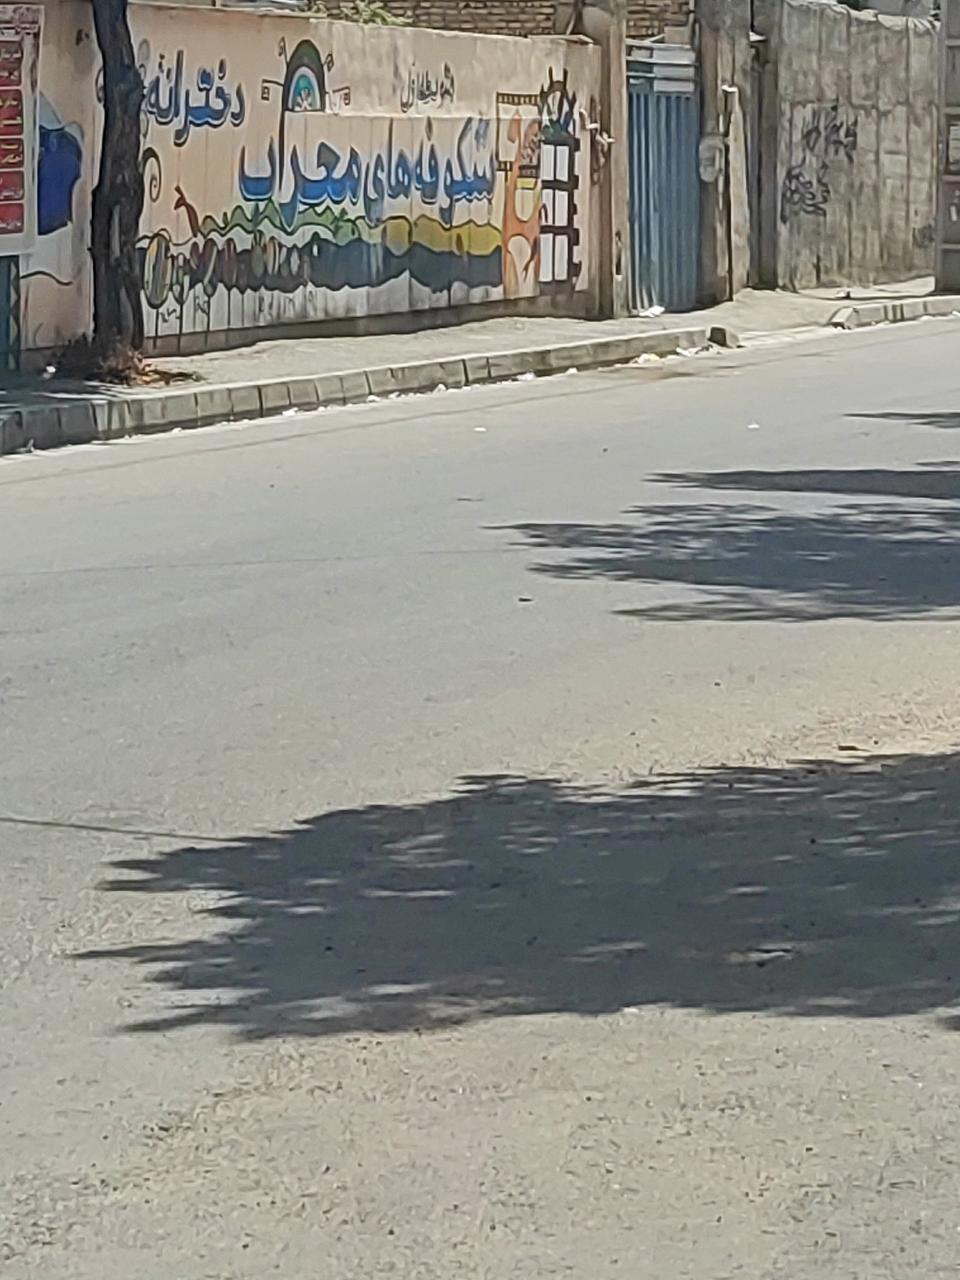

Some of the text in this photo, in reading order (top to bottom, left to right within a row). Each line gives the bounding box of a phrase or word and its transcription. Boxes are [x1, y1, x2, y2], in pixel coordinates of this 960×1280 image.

[144, 50, 245, 147] دخترانه
[239, 111, 495, 233] شکوفه های محراب
